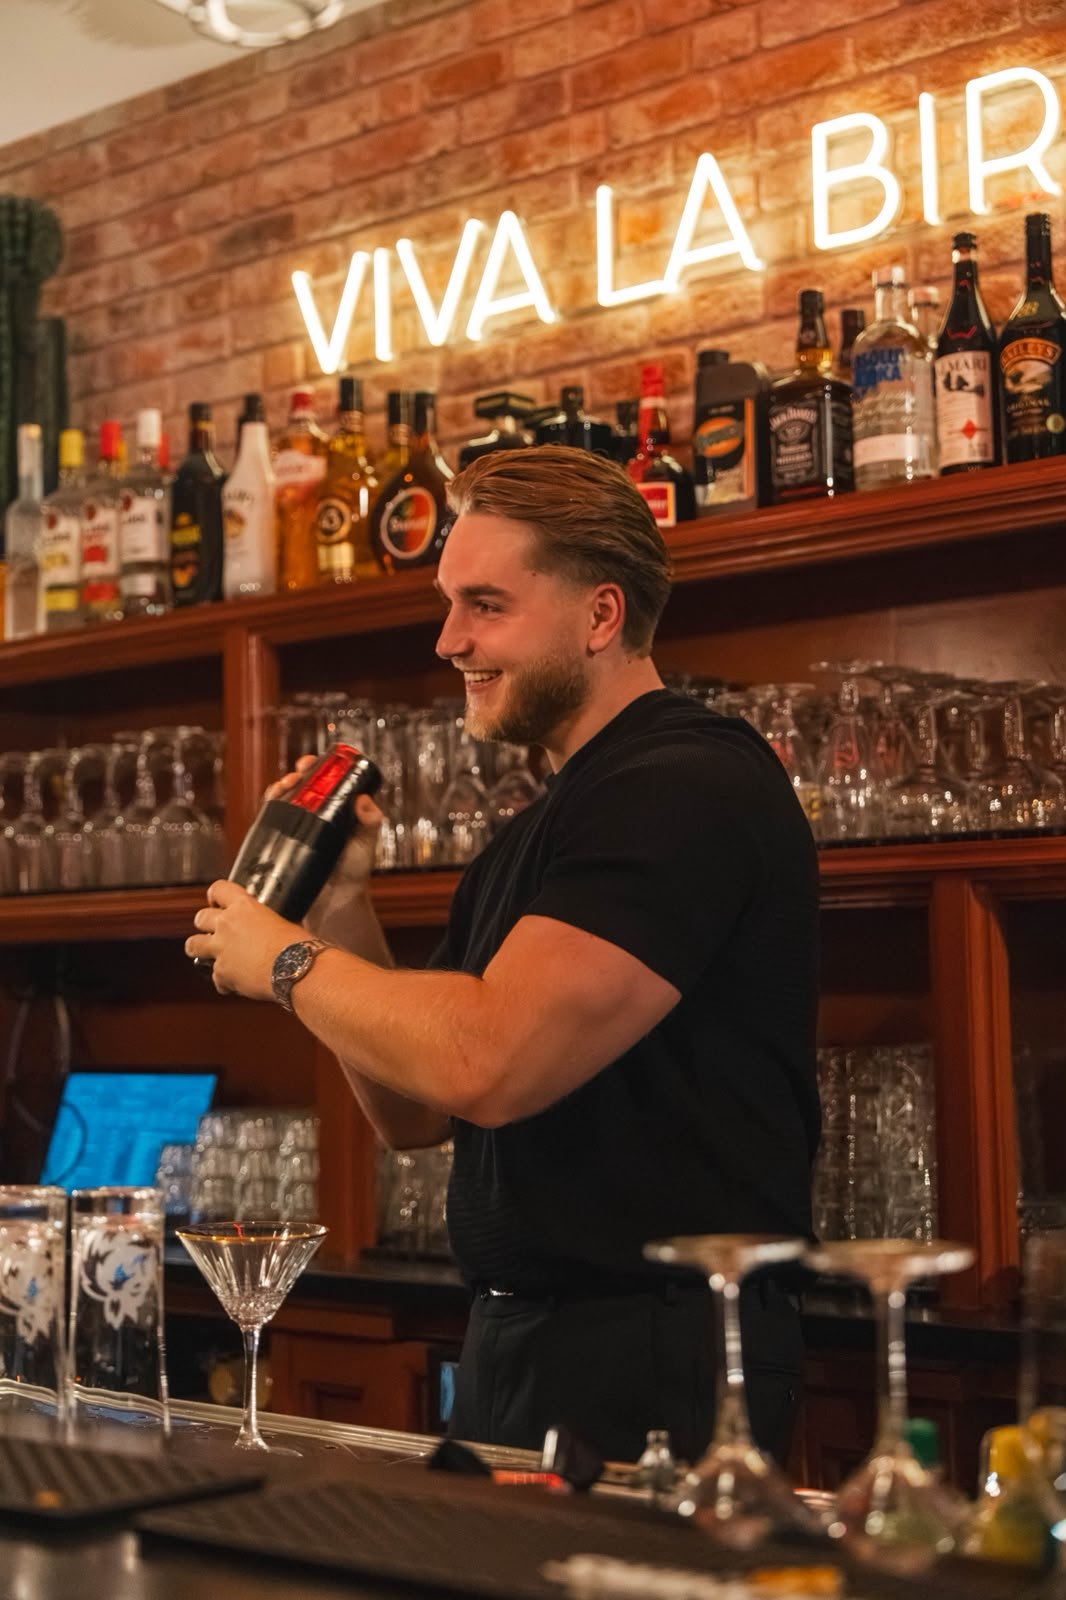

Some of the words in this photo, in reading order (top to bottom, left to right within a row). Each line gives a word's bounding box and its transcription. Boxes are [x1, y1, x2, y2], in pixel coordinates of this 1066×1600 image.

[291, 210, 556, 375] VIVA
[596, 152, 765, 307] LA
[812, 67, 1062, 250] BIR
